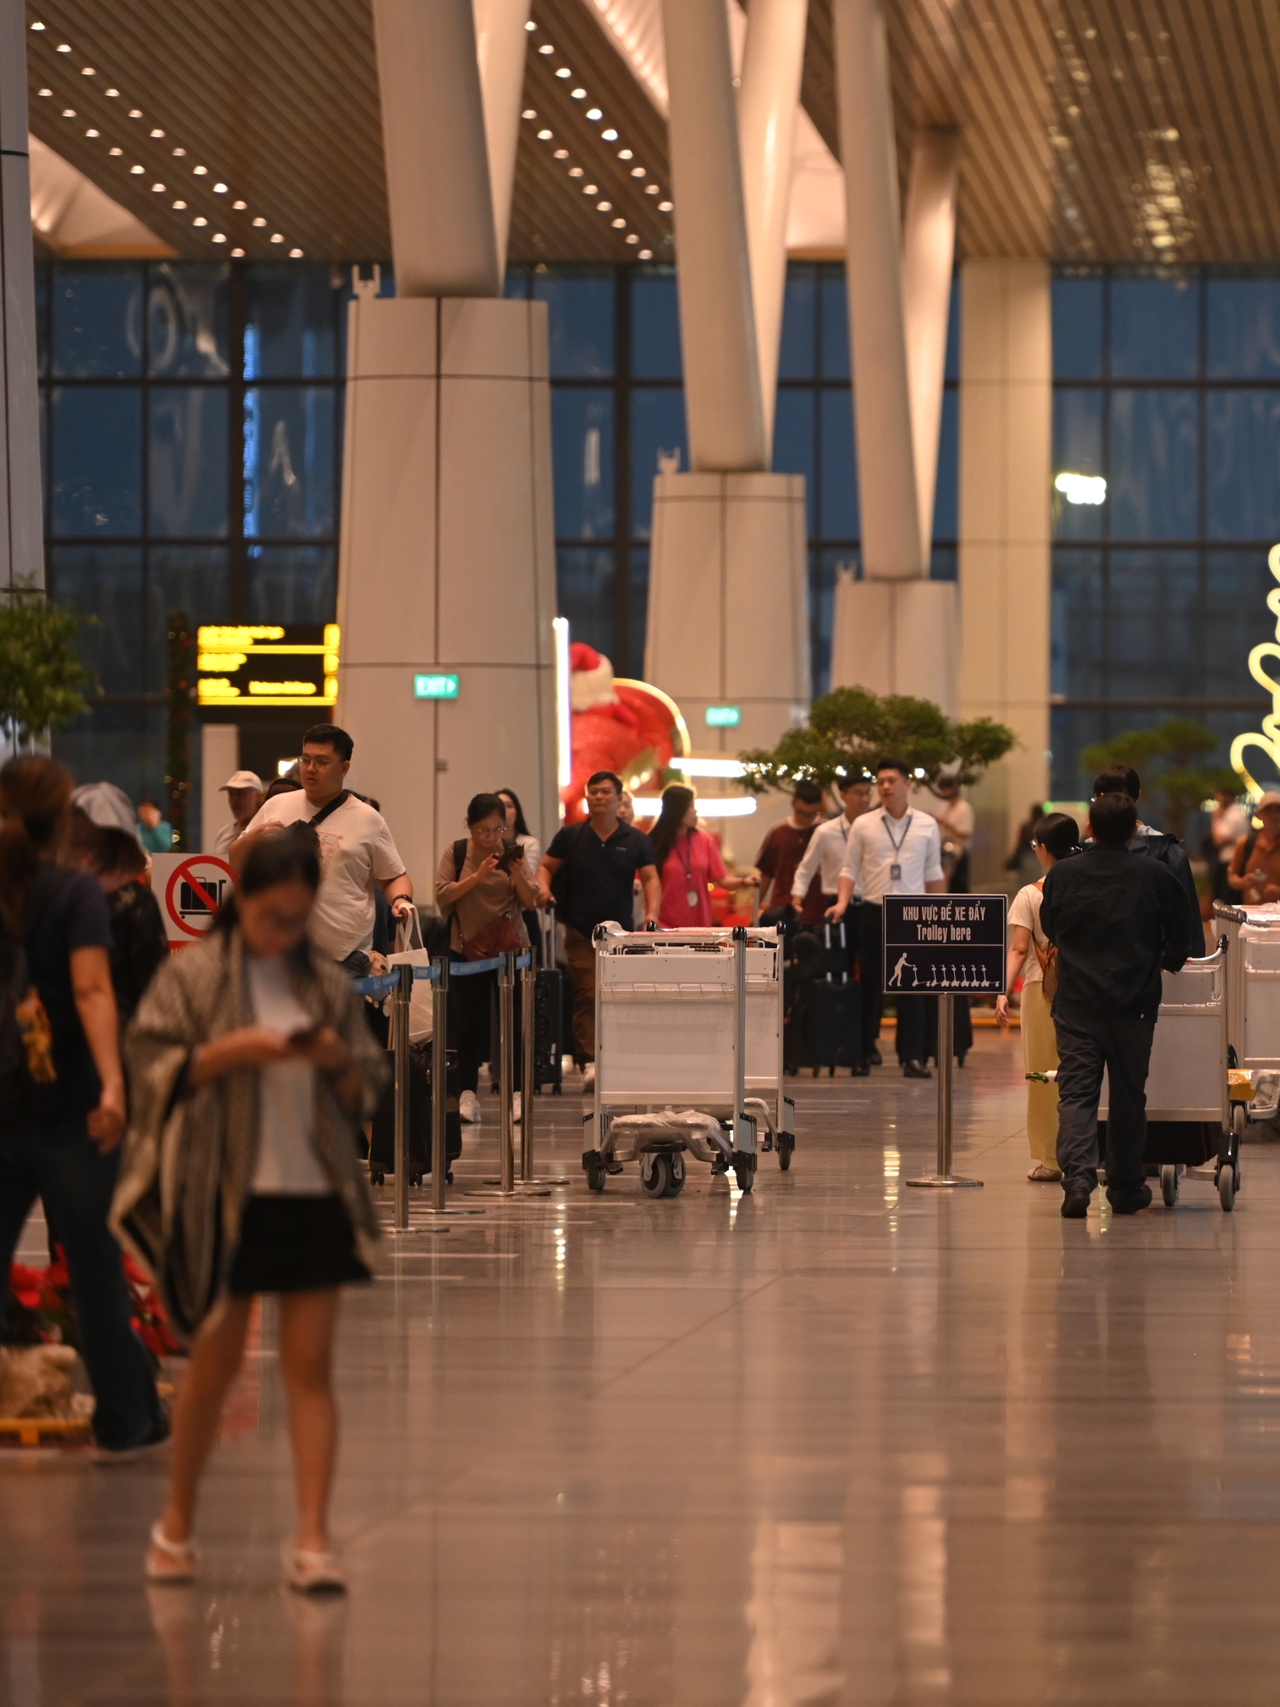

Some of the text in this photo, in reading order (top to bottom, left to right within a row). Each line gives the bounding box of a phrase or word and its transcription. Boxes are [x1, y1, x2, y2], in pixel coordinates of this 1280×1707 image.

[903, 900, 986, 924] KHU VỰC ĐỂ XE ĐẨY
[917, 924, 971, 943] Trolley here
